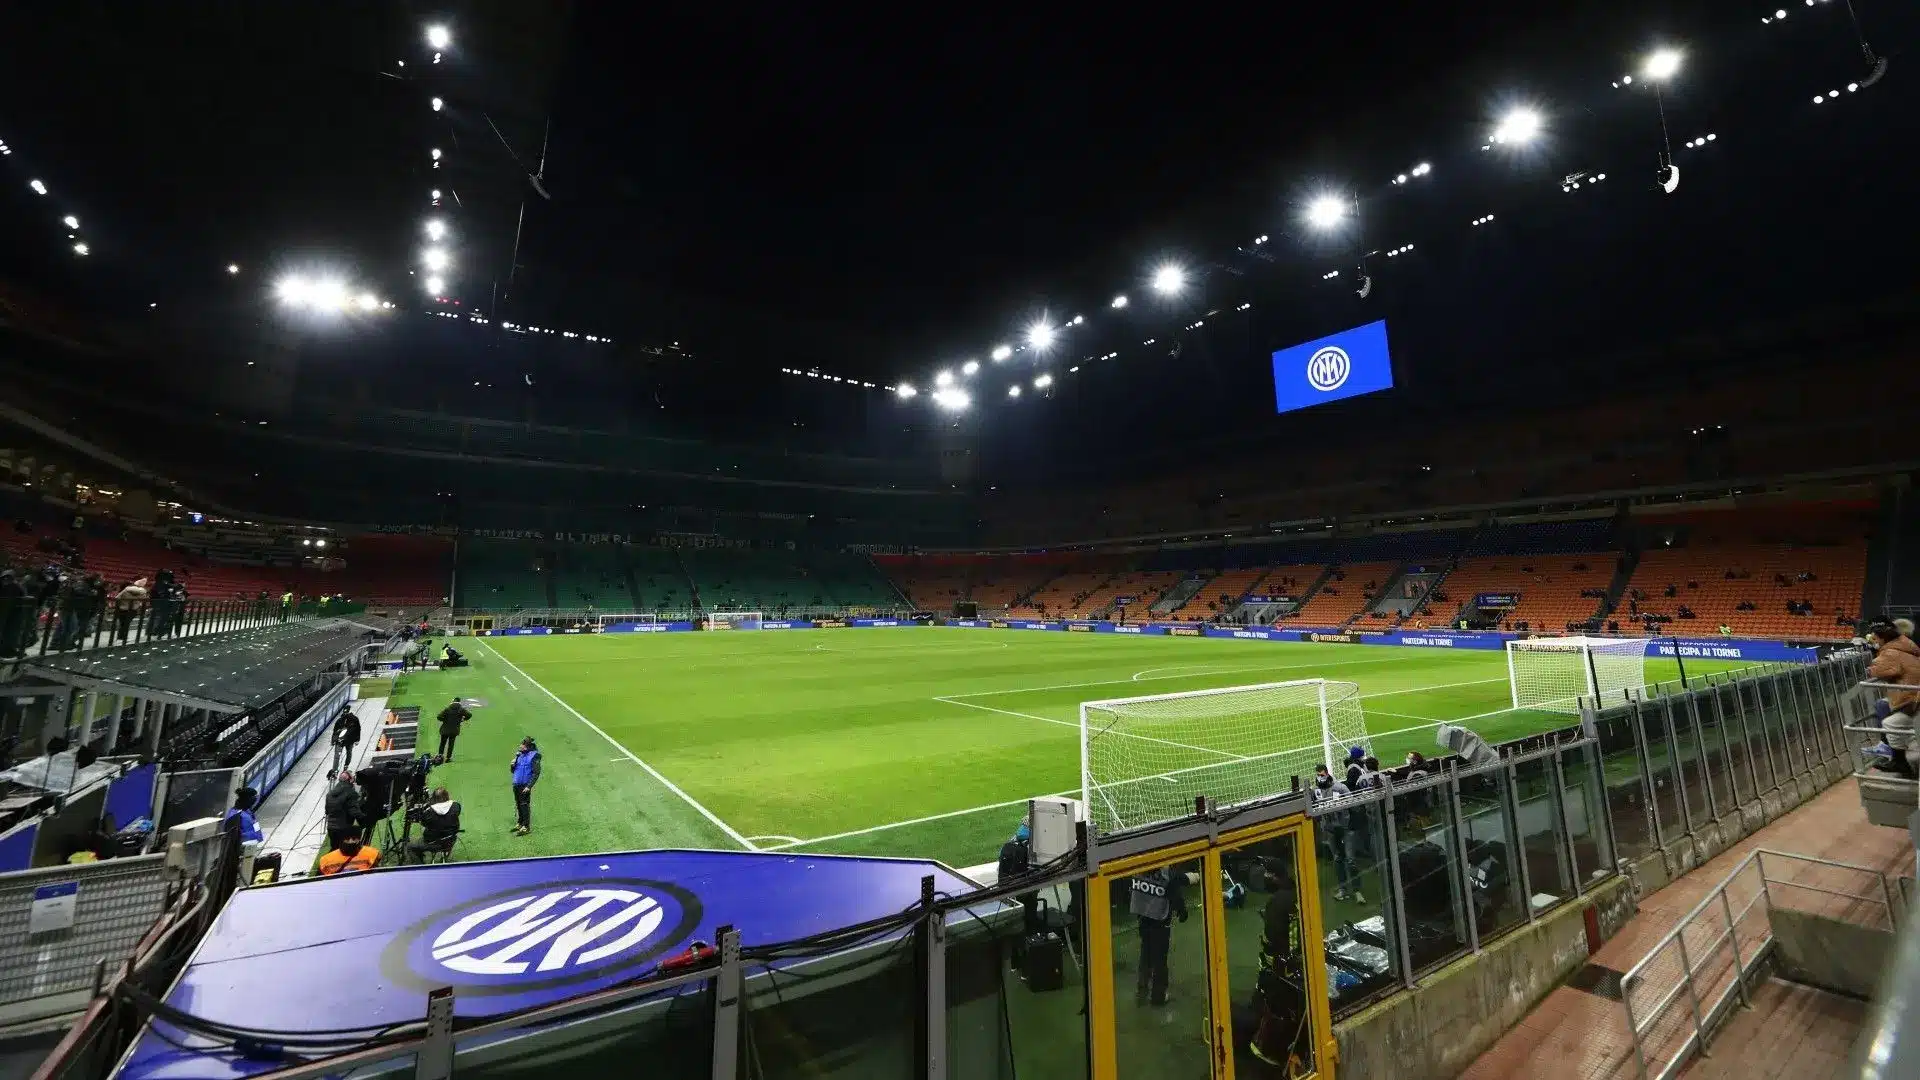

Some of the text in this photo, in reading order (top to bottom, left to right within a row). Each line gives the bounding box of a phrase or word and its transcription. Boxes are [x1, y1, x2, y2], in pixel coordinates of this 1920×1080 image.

[1402, 637, 1427, 645] PARTECIPA
[1659, 646, 1742, 658] PARECIPA AI TORNEI
[1129, 878, 1166, 896] HOTO
